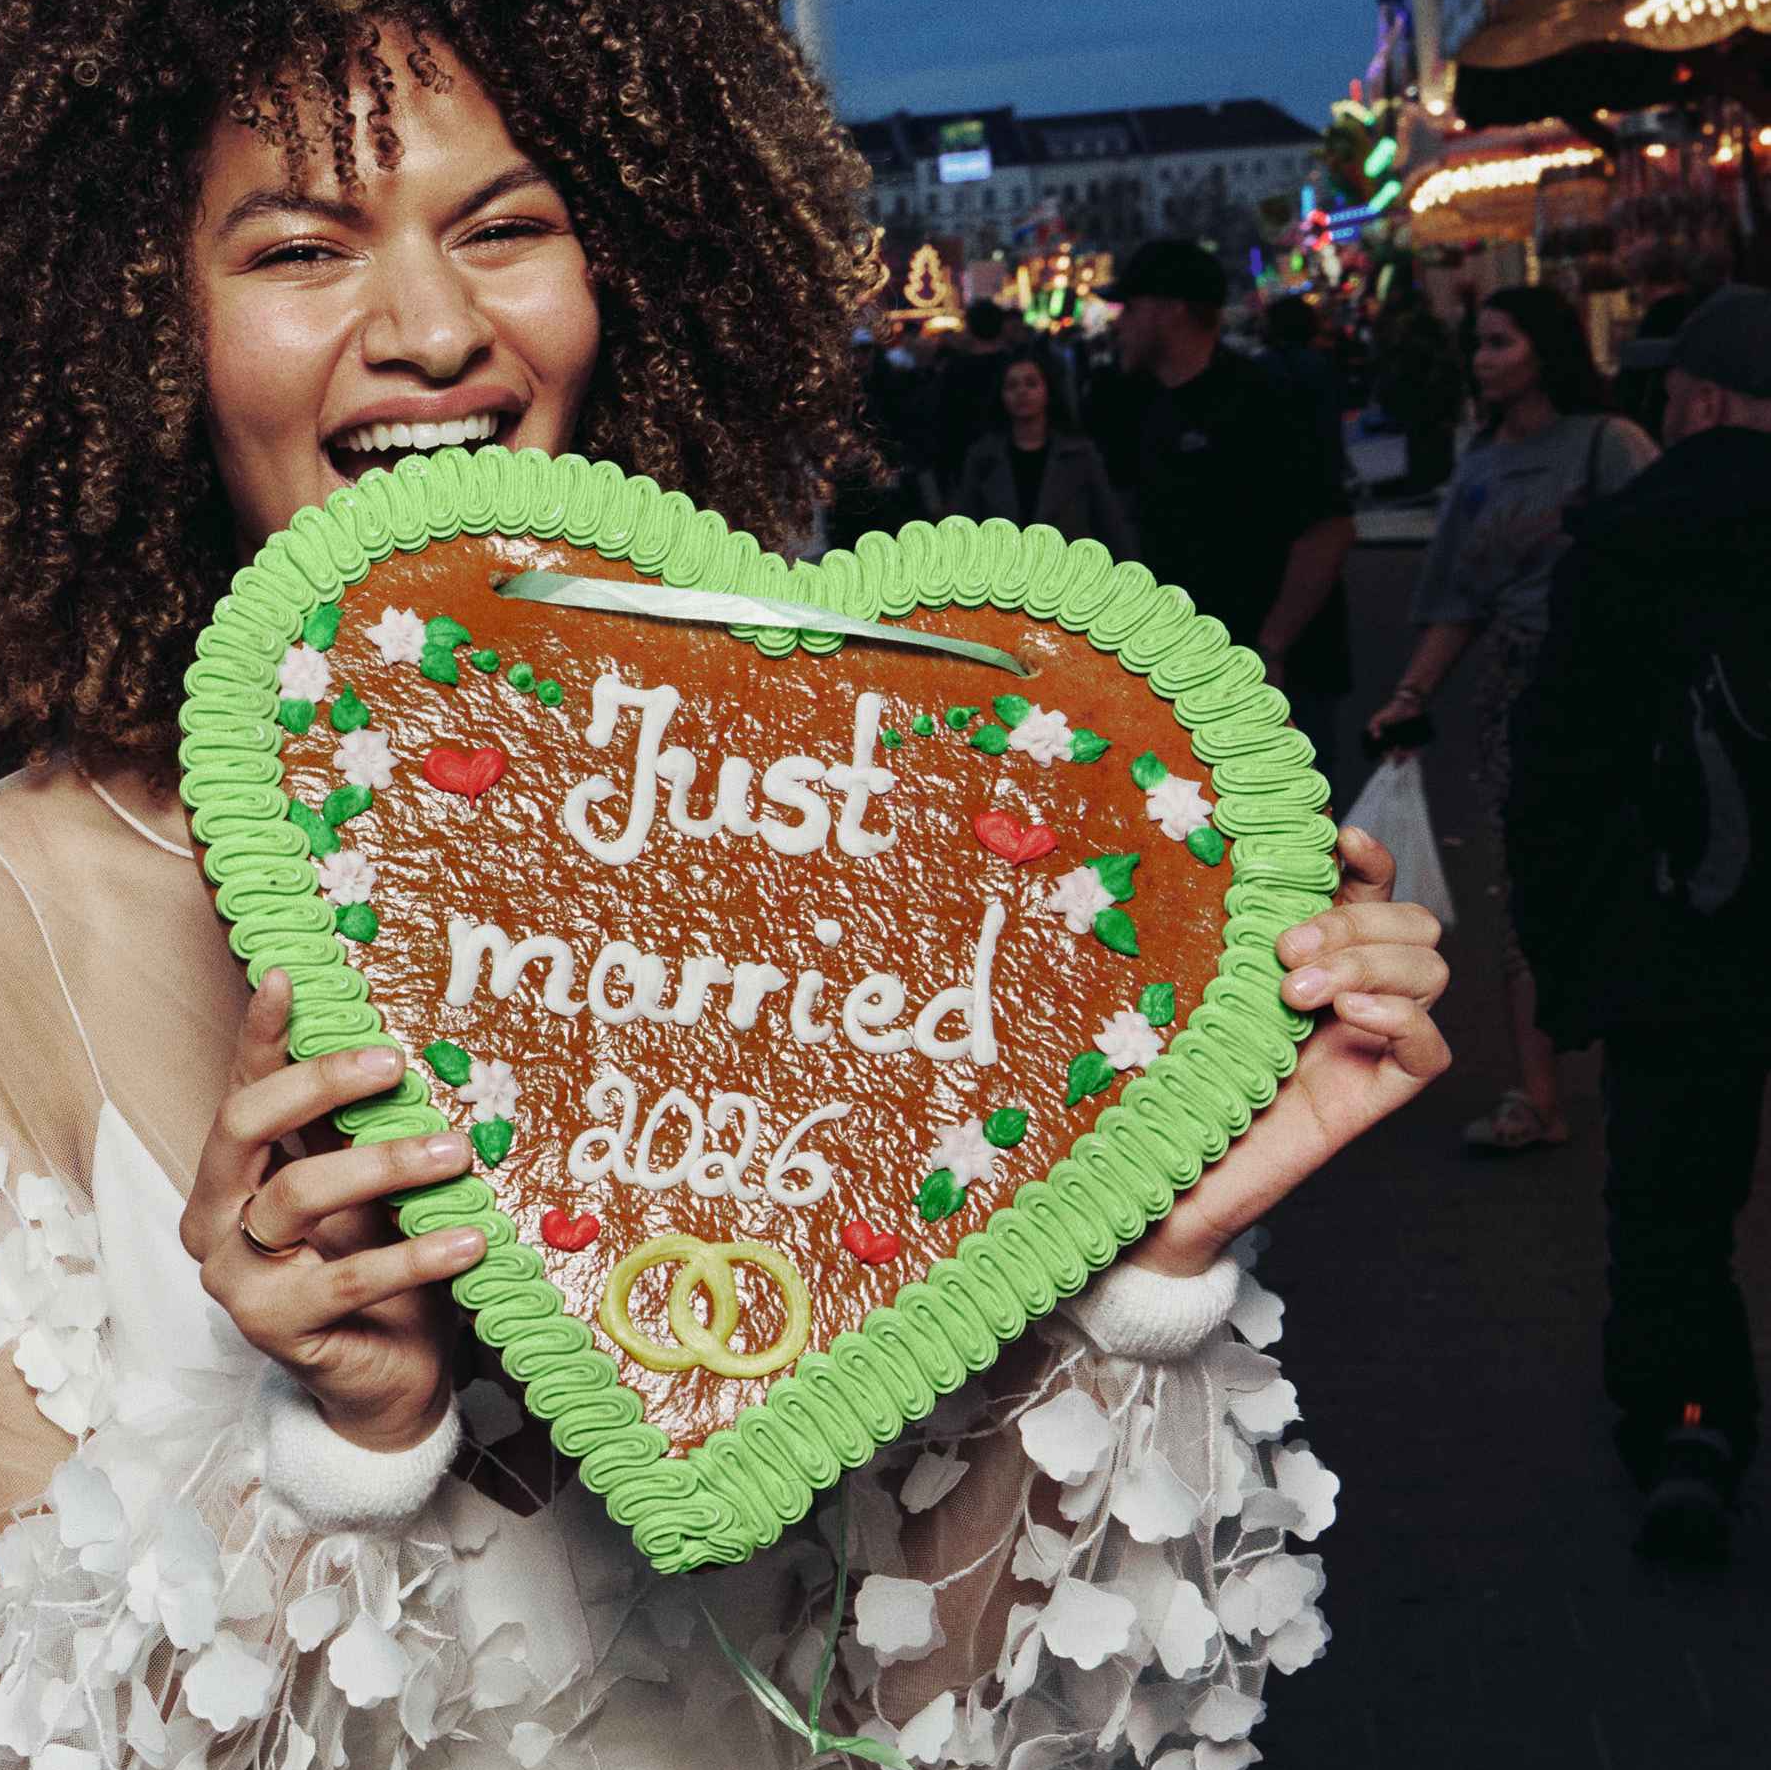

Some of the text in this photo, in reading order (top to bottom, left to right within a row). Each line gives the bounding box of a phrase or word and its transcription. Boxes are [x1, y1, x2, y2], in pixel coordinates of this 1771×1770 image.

[561, 673, 899, 866] Just
[445, 897, 1005, 1066] married
[568, 1074, 852, 1207] 2026
